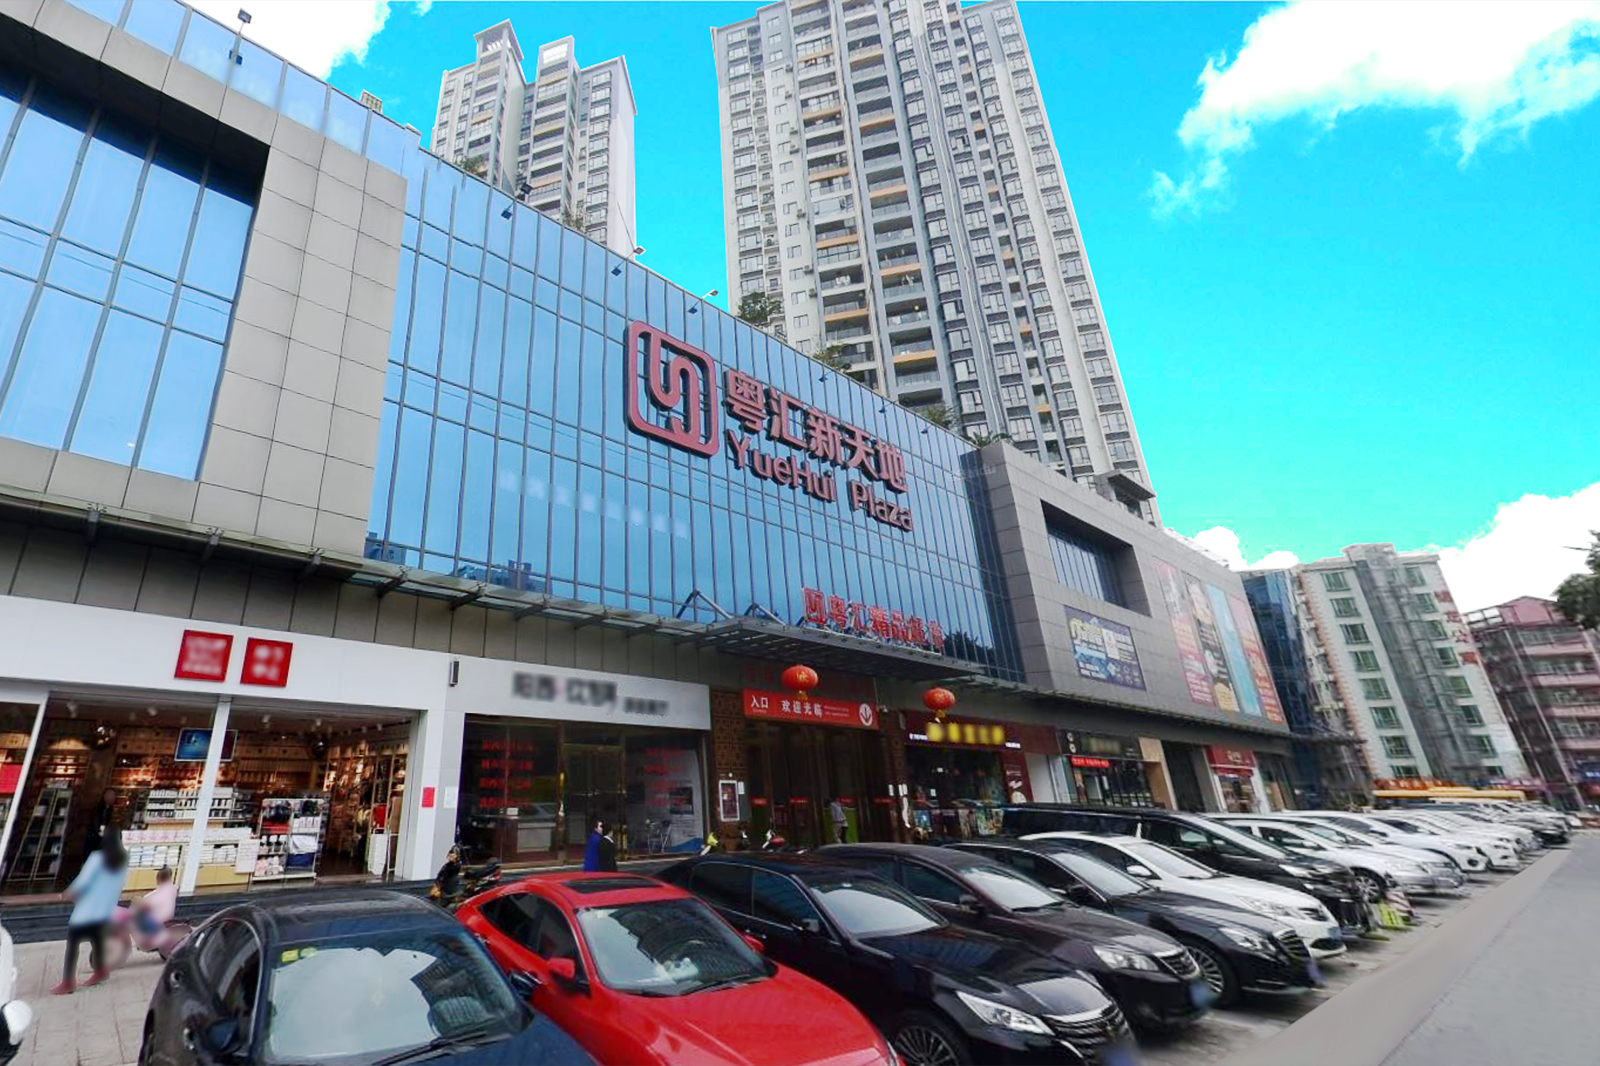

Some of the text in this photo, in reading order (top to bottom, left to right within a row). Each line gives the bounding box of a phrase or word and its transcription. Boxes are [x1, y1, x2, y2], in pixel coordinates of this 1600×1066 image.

[724, 370, 909, 493] 粤汇新天地
[725, 429, 913, 532] YueHui Plaza
[751, 695, 769, 709] 入口
[781, 699, 823, 718] 欢迎光临
